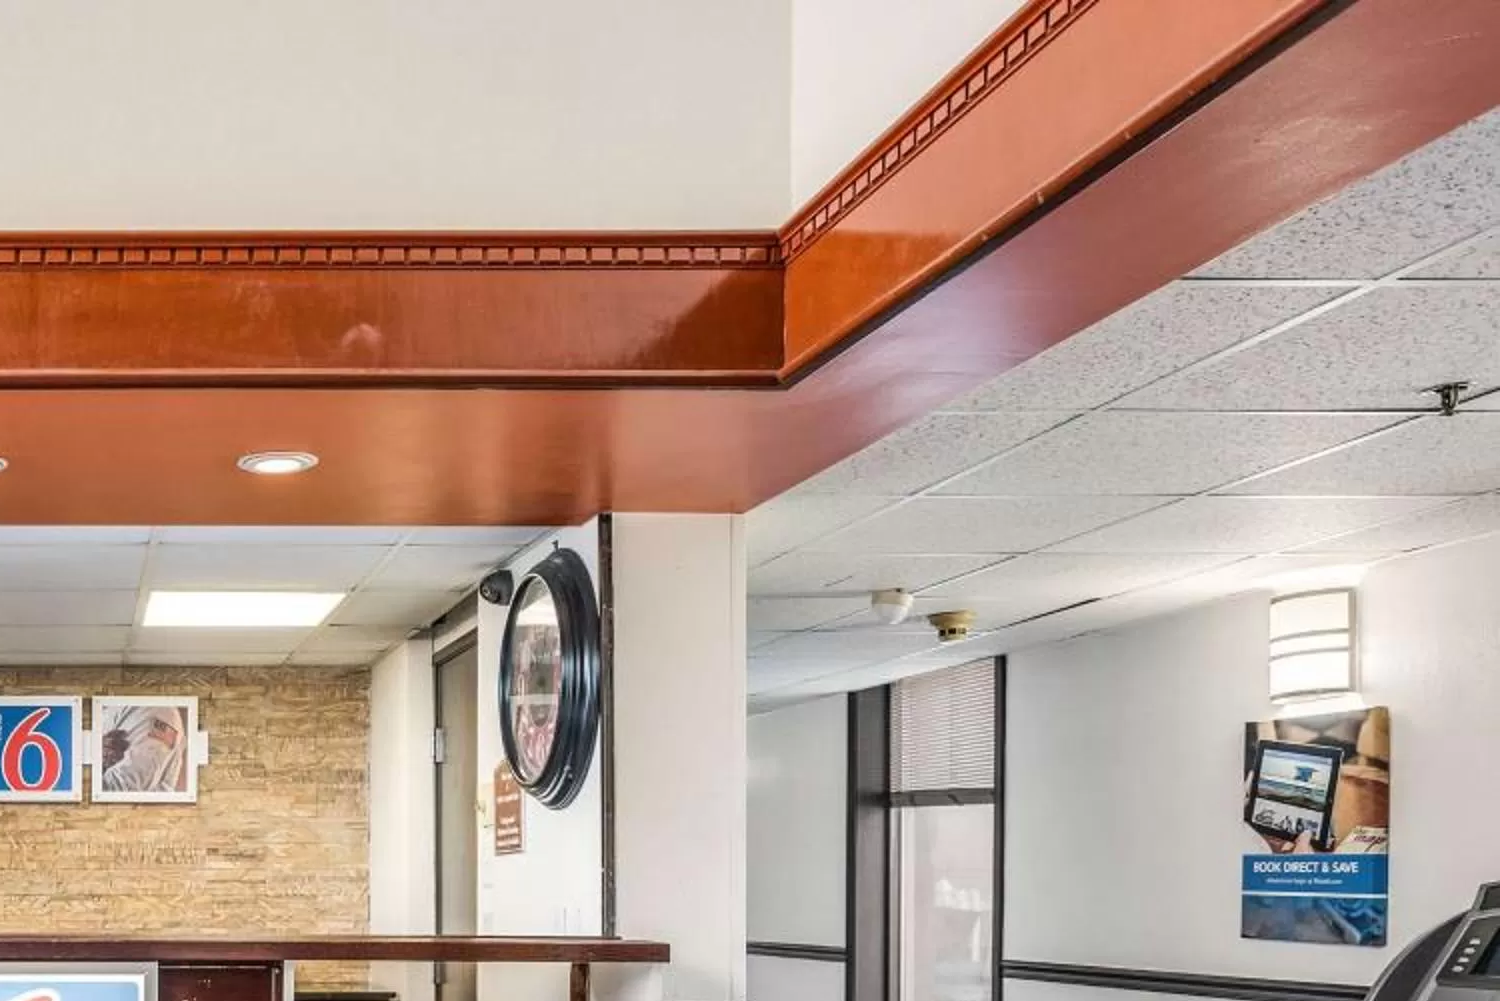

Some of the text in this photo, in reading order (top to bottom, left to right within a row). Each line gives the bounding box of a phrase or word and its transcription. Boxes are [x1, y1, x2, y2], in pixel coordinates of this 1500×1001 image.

[1, 707, 63, 792] 6
[1253, 861, 1282, 873] BOOK
[1283, 861, 1319, 873] DIRECT
[1331, 861, 1359, 873] SAVE
